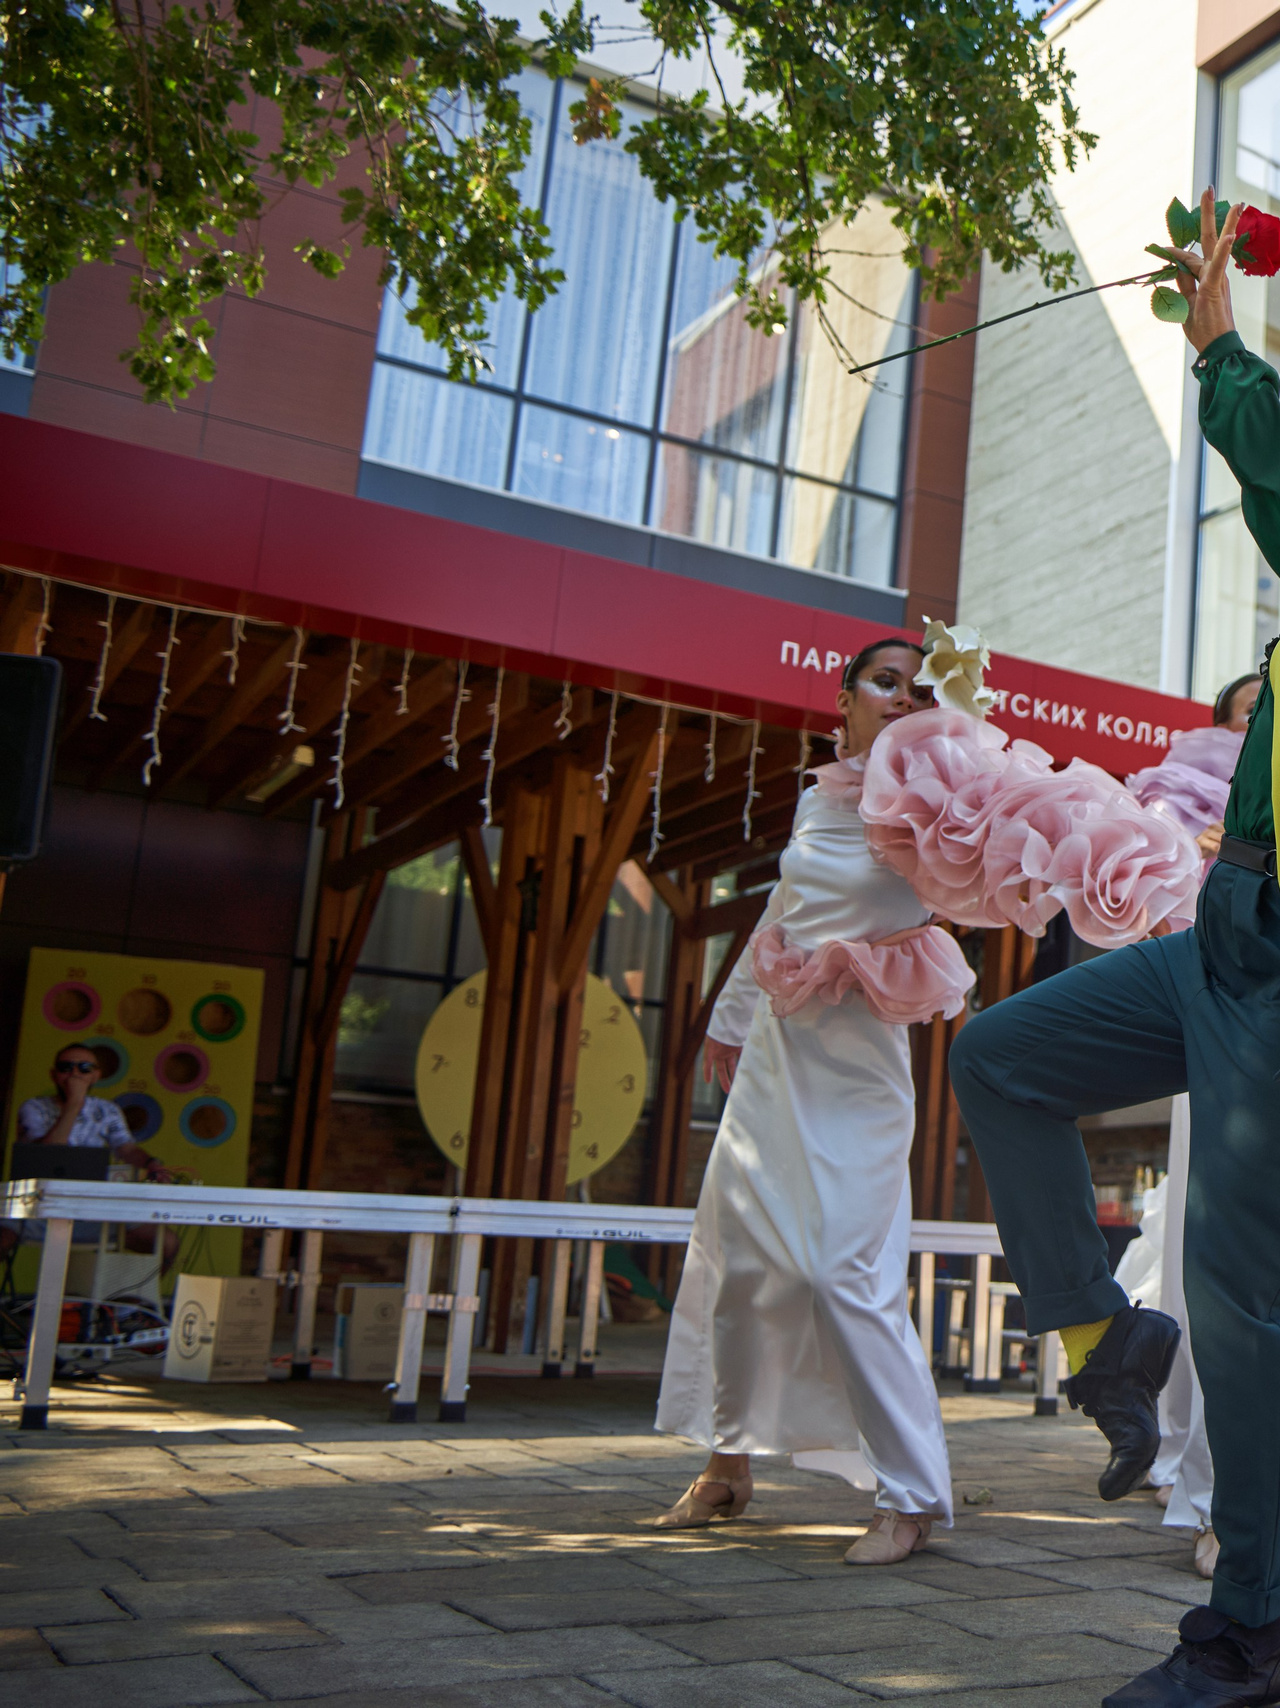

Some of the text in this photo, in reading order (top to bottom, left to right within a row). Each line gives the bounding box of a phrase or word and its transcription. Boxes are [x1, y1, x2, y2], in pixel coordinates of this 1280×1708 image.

[984, 686, 1087, 731] ТСКИХ
[1097, 712, 1184, 748] КОЛЯ
[465, 988, 479, 1008] 8
[604, 1005, 621, 1025] 2
[431, 1053, 446, 1073] 7
[621, 1074, 636, 1094] 3
[450, 1130, 465, 1150] 6
[584, 1142, 599, 1160] 4
[218, 1214, 279, 1226] GUIL
[602, 1229, 652, 1239] GUIL
